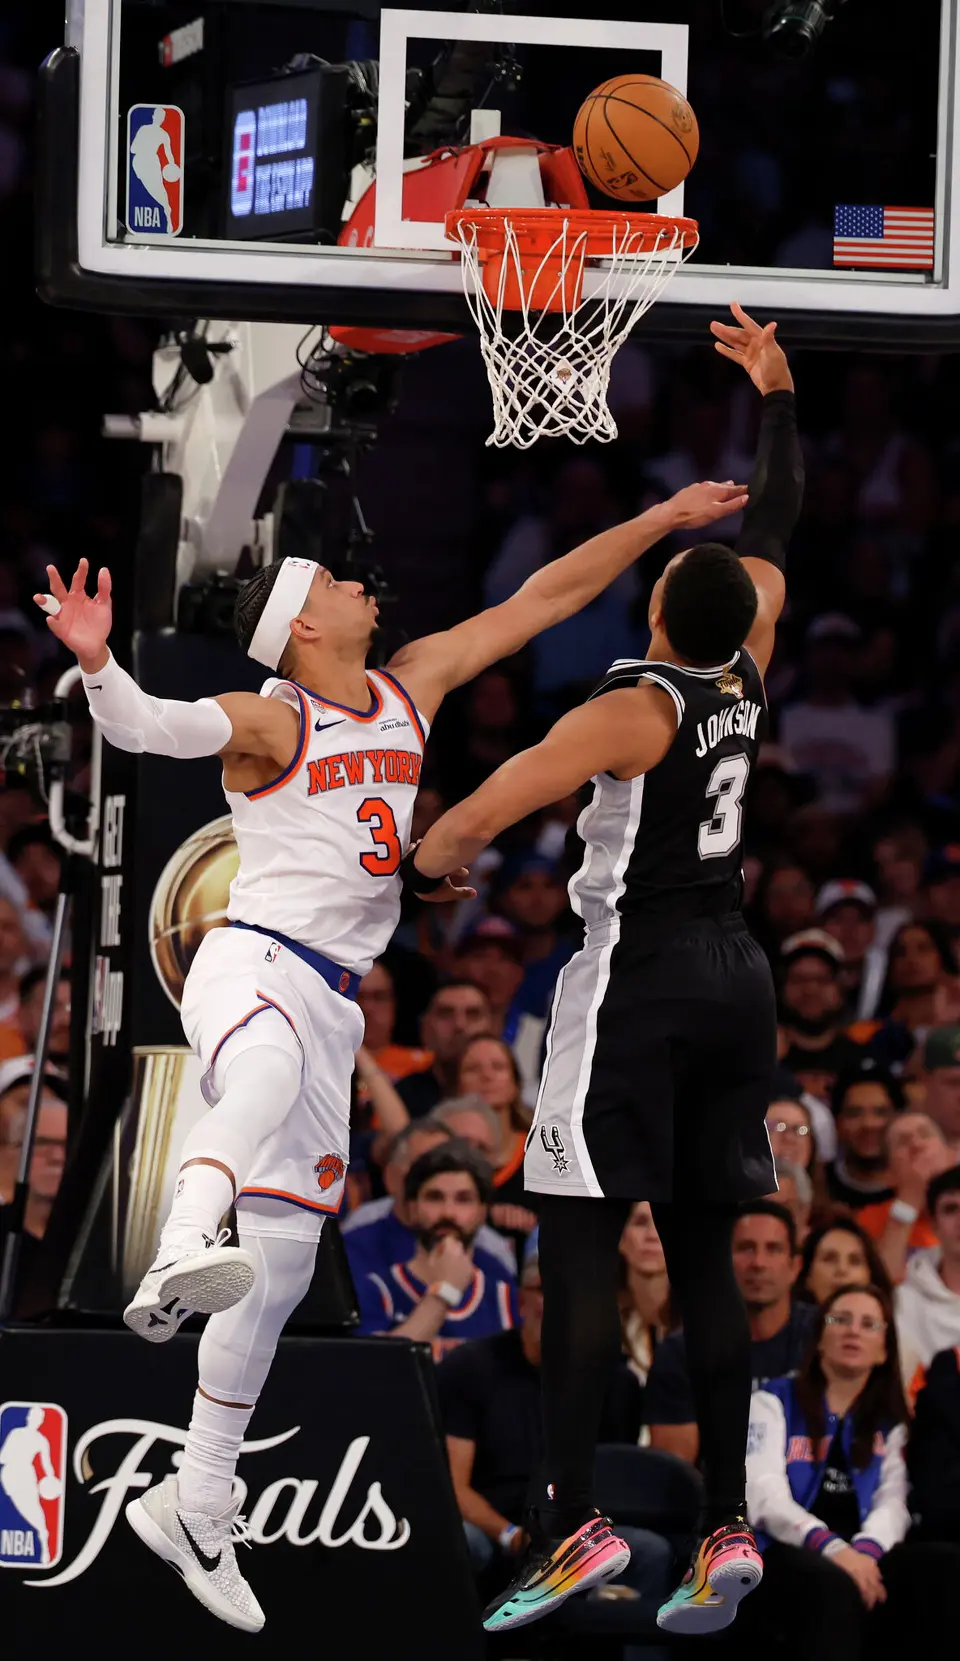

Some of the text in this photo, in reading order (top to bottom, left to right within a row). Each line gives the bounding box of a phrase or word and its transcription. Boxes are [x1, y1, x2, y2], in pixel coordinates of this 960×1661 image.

[134, 206, 161, 228] NBA
[695, 699, 762, 759] JOHNSON
[307, 749, 422, 797] NEW YORK
[697, 751, 750, 861] 3
[356, 796, 403, 878] 3
[0, 1529, 35, 1557] NBA
